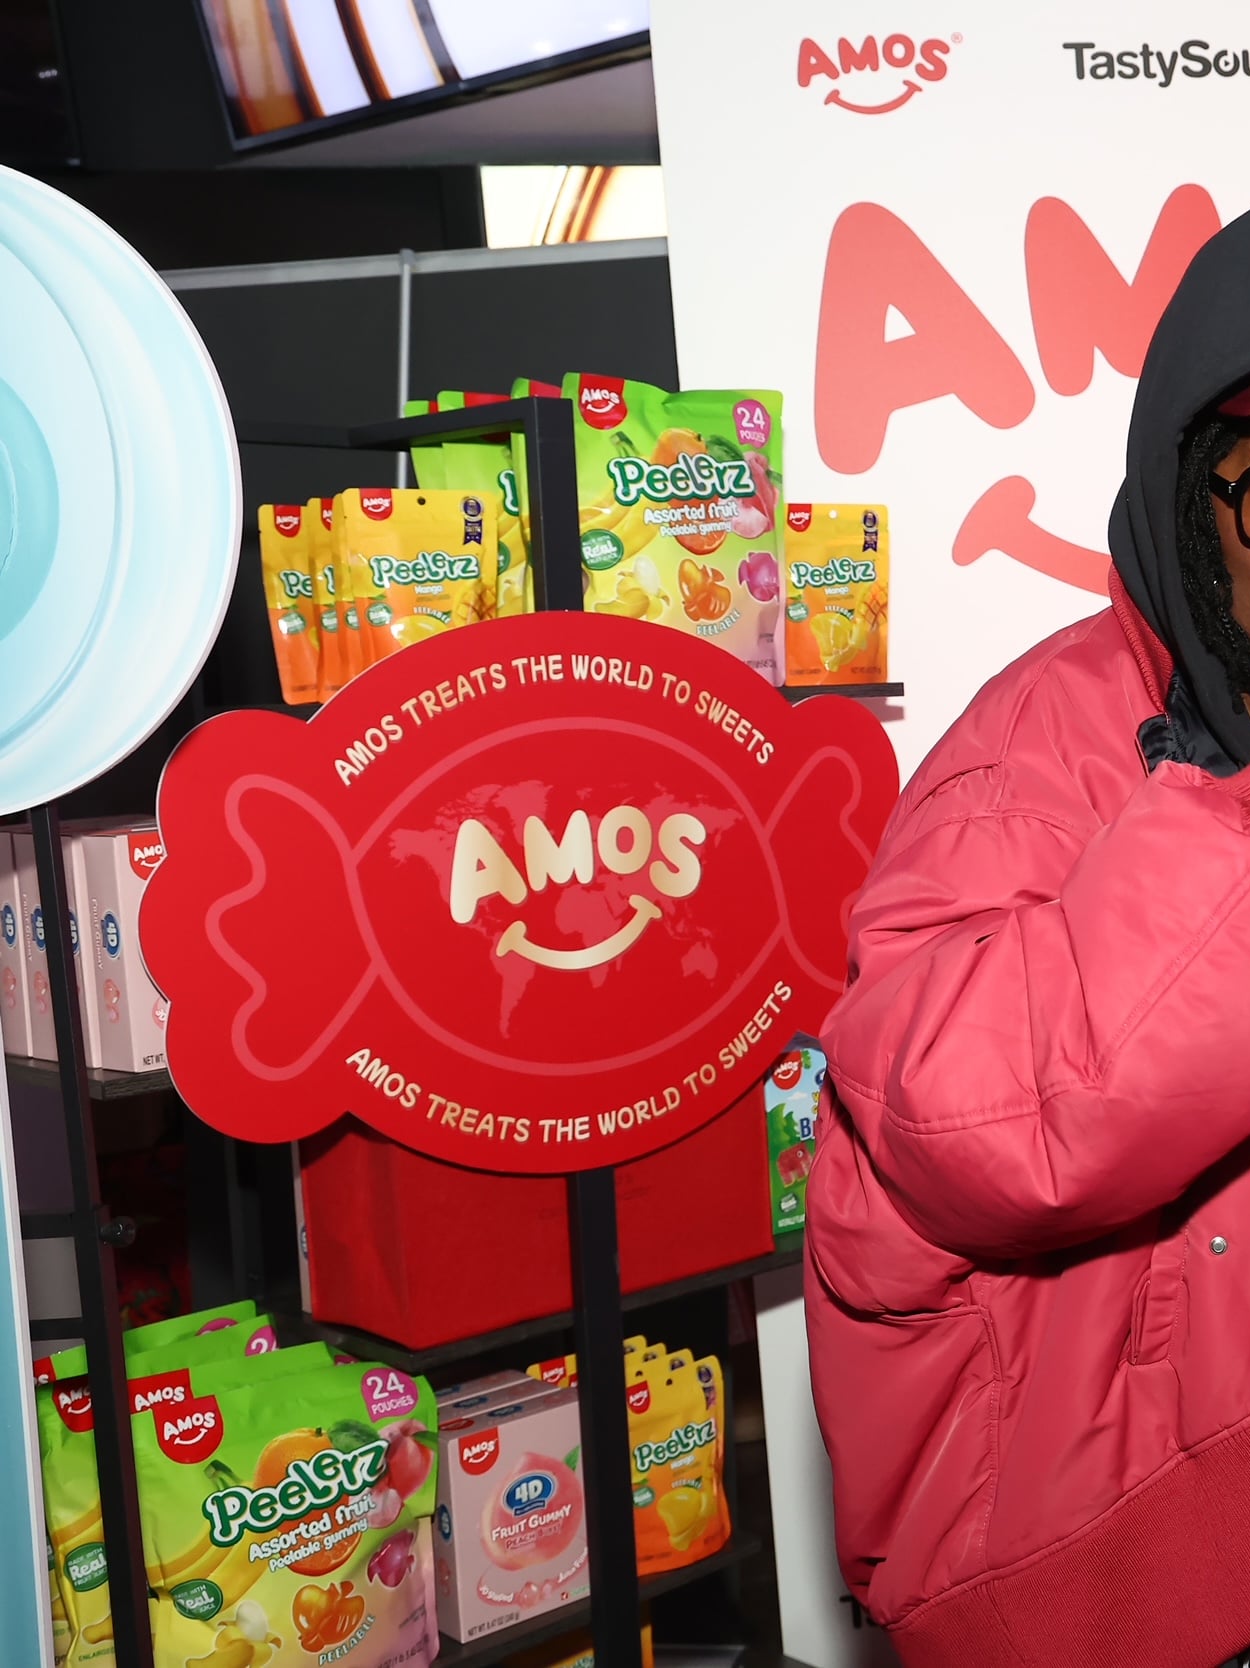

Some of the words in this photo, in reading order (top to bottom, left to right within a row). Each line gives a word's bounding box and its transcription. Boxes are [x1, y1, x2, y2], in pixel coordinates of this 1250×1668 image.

[581, 388, 620, 404] AMOS
[736, 407, 766, 430] 24
[643, 505, 706, 524] Assorted
[708, 499, 739, 520] fruit
[660, 523, 698, 537] Peelable
[699, 521, 732, 535] gummy
[370, 551, 480, 587] Peelerz
[790, 557, 876, 589] Peelerz
[414, 584, 443, 595] Mango
[825, 586, 849, 595] Mango
[696, 608, 741, 636] PEELABLE
[334, 714, 403, 786] AMOS
[400, 663, 507, 726] TREATS
[511, 654, 563, 685] THE
[571, 654, 654, 691] WORLD
[661, 672, 691, 704] TO
[694, 690, 775, 765] SWEETS
[134, 845, 164, 862] AMO
[450, 804, 706, 923] AMOS
[106, 921, 118, 947] 4D
[345, 1048, 422, 1108] AMOS
[426, 1093, 531, 1143] TREATS
[538, 1116, 590, 1143] THE
[597, 1086, 681, 1136] WORLD
[683, 1063, 717, 1095] TO
[718, 980, 792, 1070] SWEETS
[134, 1386, 185, 1411] AMOS
[366, 1372, 405, 1400] 24
[371, 1396, 414, 1415] POUCHES
[163, 1411, 216, 1440] AMOS
[462, 1440, 496, 1461] AMOS
[635, 1420, 716, 1473] Peelerz
[204, 1440, 389, 1546] Peelerz
[515, 1479, 544, 1503] 4D
[249, 1512, 332, 1563] Assorted
[335, 1491, 376, 1525] fruit
[491, 1520, 527, 1542] FRUIT
[528, 1504, 571, 1529] GUMMY
[268, 1540, 321, 1573] Peelable
[324, 1518, 369, 1551] gummy
[69, 1552, 107, 1581] Real
[318, 1615, 375, 1667] PEELABLE
